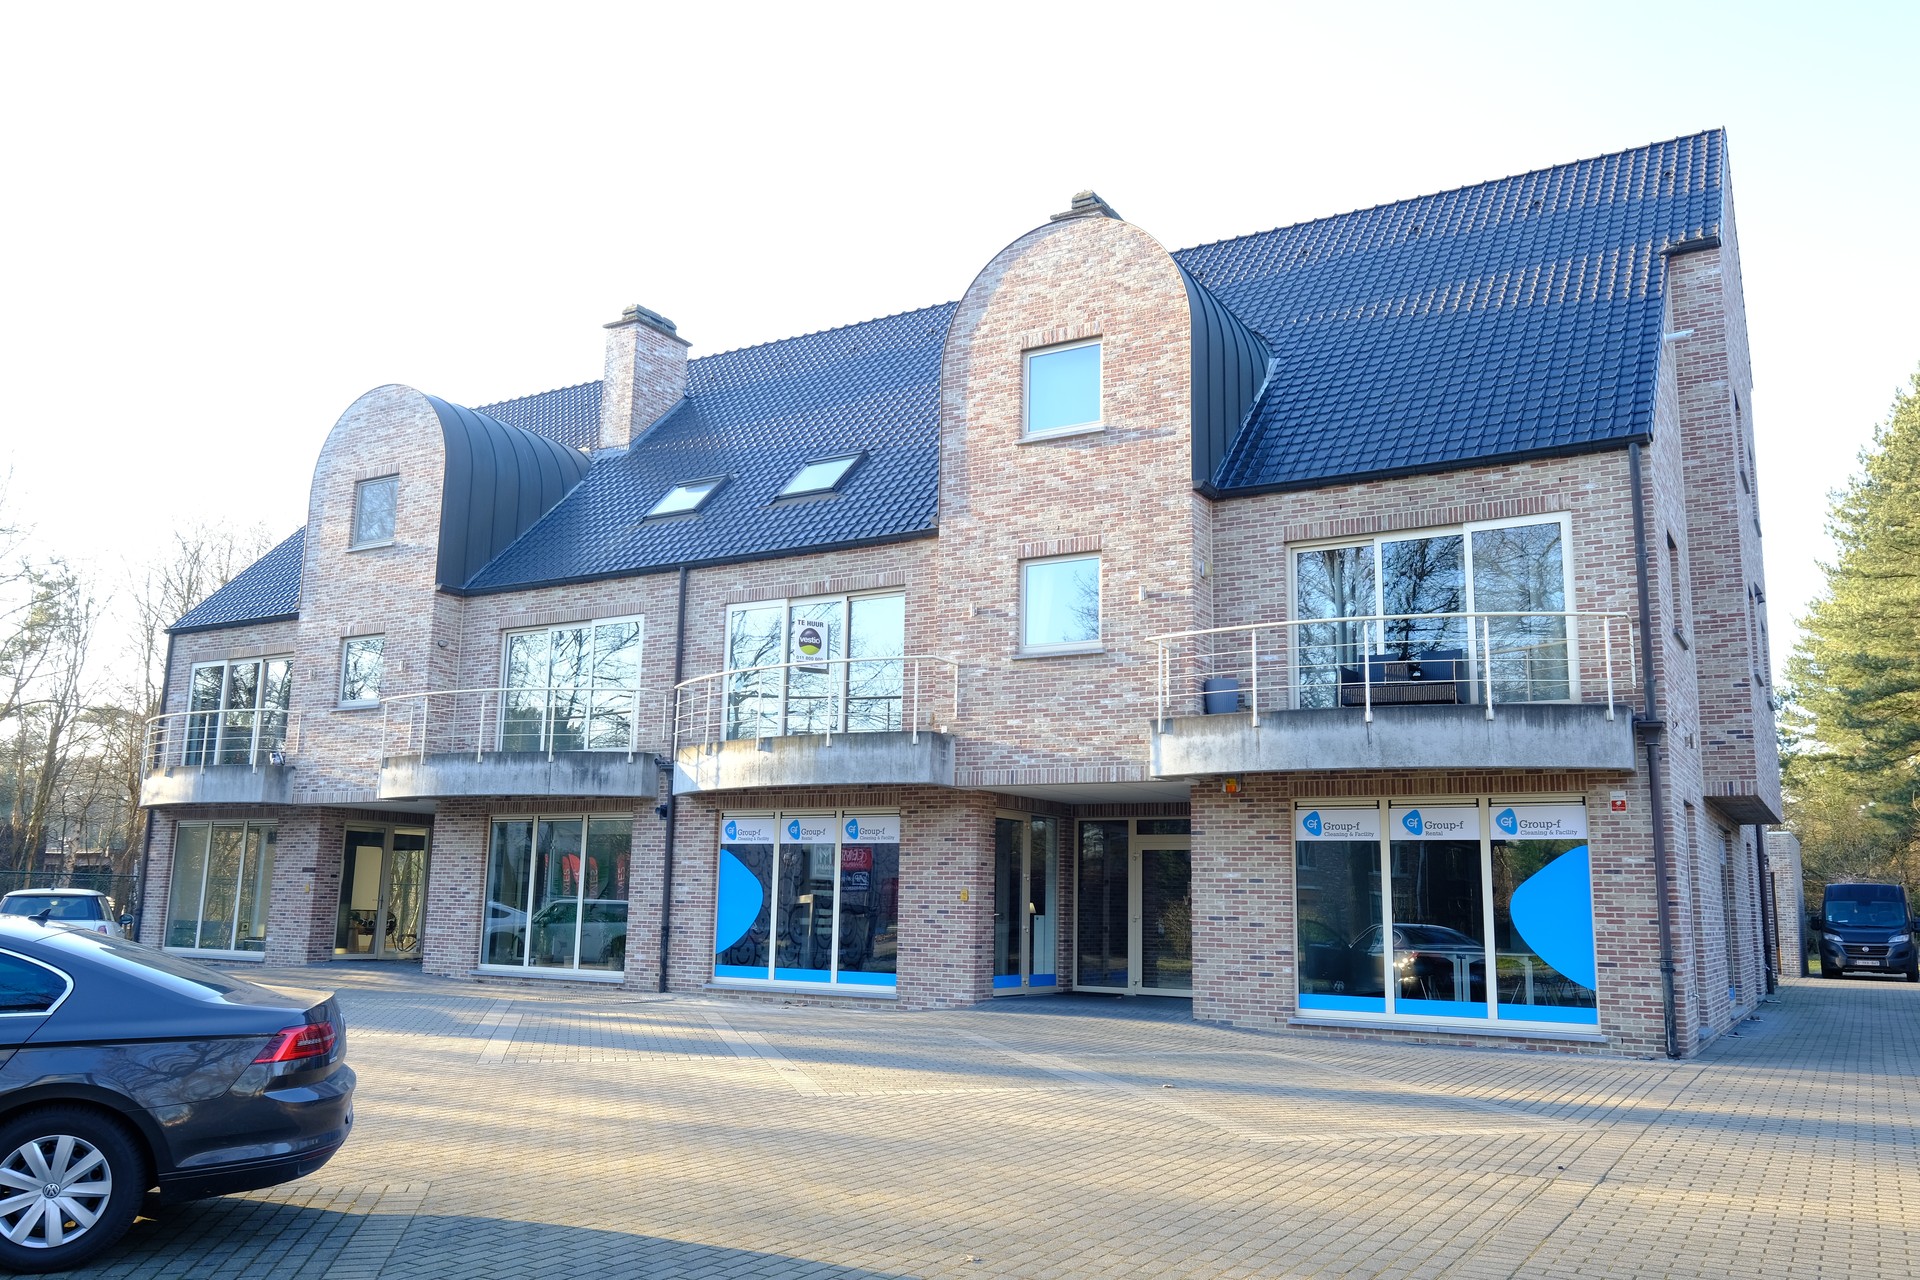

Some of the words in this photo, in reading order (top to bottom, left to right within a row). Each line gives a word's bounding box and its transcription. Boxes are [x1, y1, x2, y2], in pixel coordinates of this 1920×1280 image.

[1323, 822, 1360, 832] Group-f
[1424, 820, 1464, 831] Group-f
[1519, 819, 1561, 830] Group-f
[737, 829, 761, 837] Group-f
[801, 828, 826, 836] Group-f
[859, 827, 885, 836] Group-f
